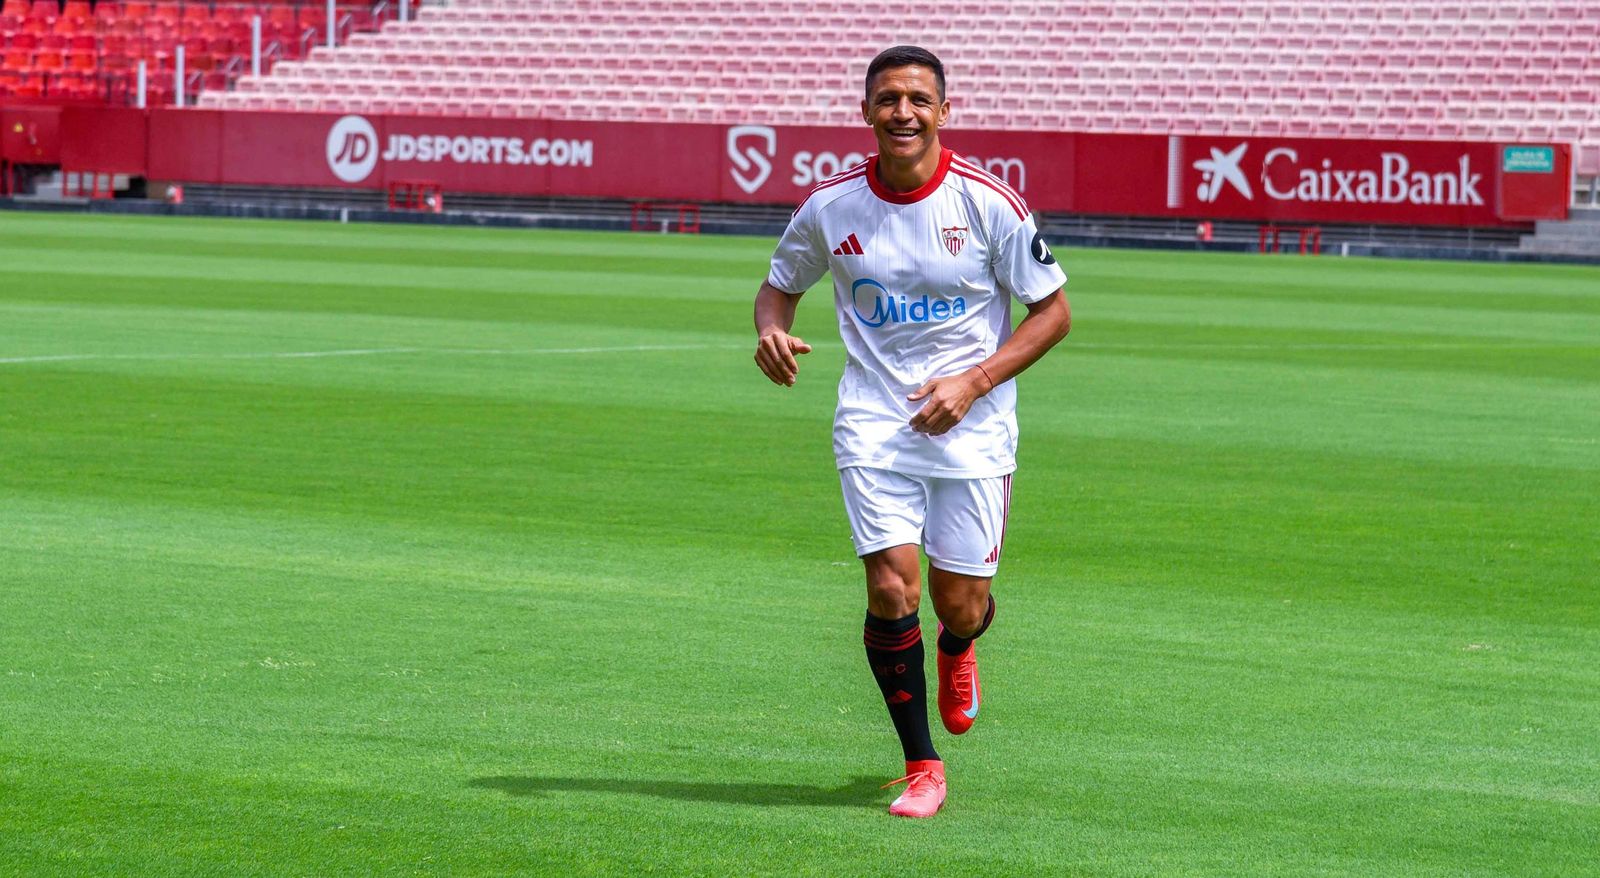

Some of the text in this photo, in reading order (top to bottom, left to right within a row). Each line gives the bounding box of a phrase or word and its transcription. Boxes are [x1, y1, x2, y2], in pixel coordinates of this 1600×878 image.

[335, 132, 369, 164] JD
[383, 134, 593, 166] JDSPORTS.COM
[1262, 147, 1483, 206] CaixaBank
[852, 278, 967, 328] Midea
